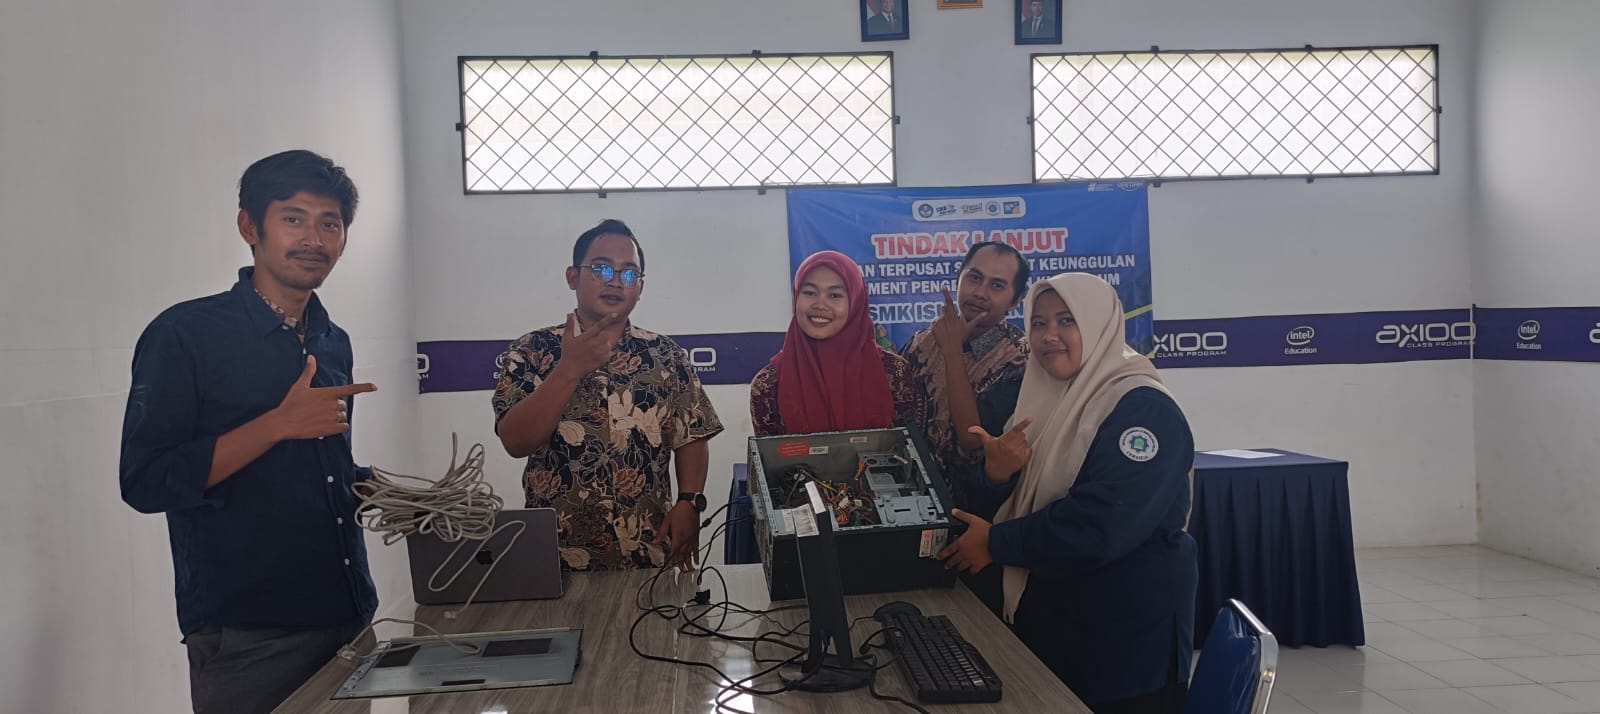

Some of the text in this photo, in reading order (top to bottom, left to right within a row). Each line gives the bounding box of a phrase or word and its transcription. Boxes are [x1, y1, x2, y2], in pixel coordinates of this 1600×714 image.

[873, 234, 968, 257] TINDAK
[879, 262, 951, 277] TERPUSAT
[1039, 254, 1135, 271] KEUNGGULAN
[869, 304, 912, 323] SMK
[1284, 347, 1317, 355] Education
[1516, 342, 1542, 350] Education
